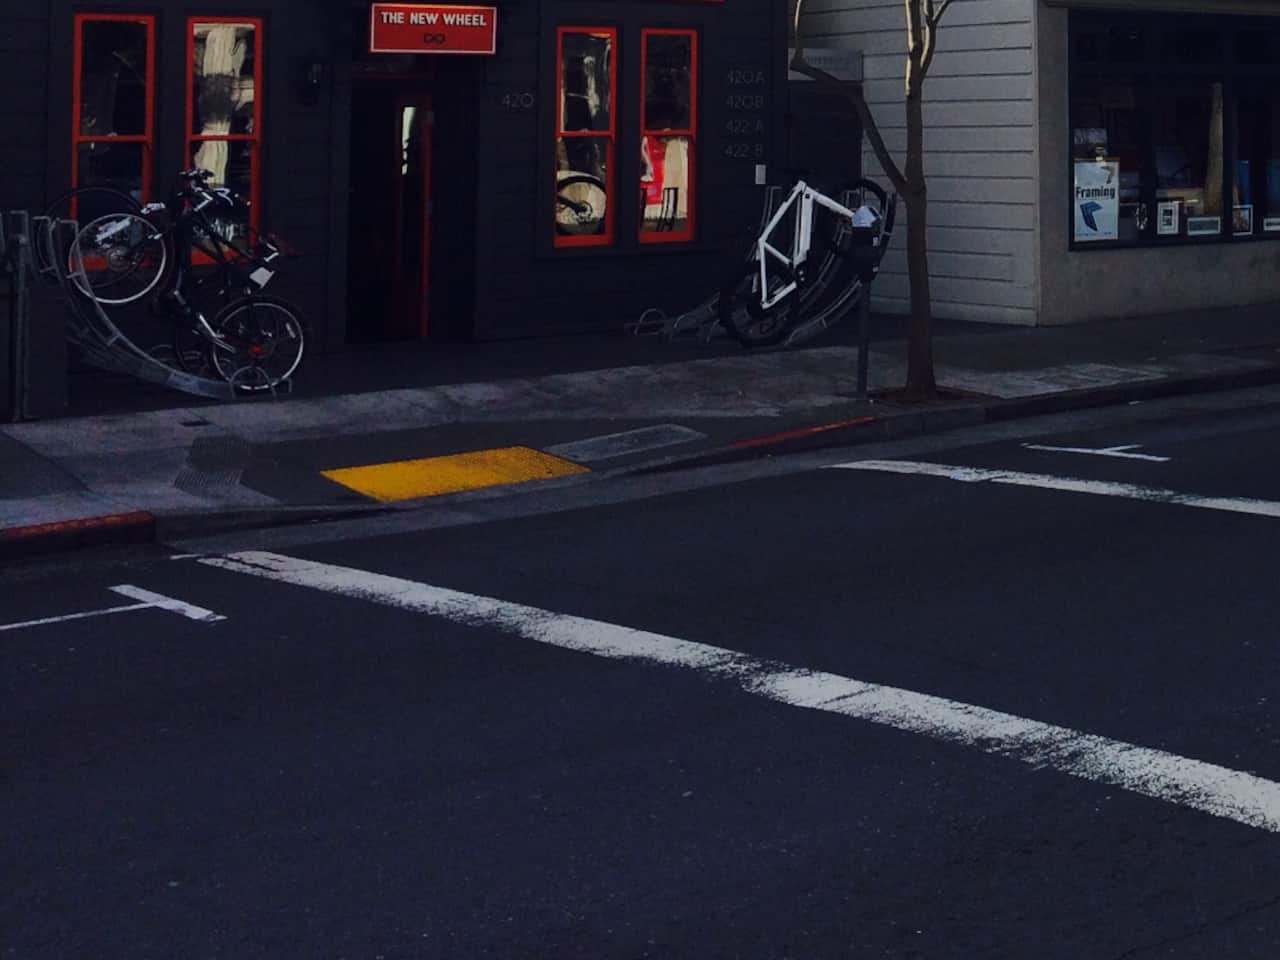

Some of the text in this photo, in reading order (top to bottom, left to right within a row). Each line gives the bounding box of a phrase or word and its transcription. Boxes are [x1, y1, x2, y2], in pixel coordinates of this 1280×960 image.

[381, 11, 487, 27] THE NEW WHEEL
[501, 93, 535, 110] 420
[1076, 186, 1116, 200] Framing
